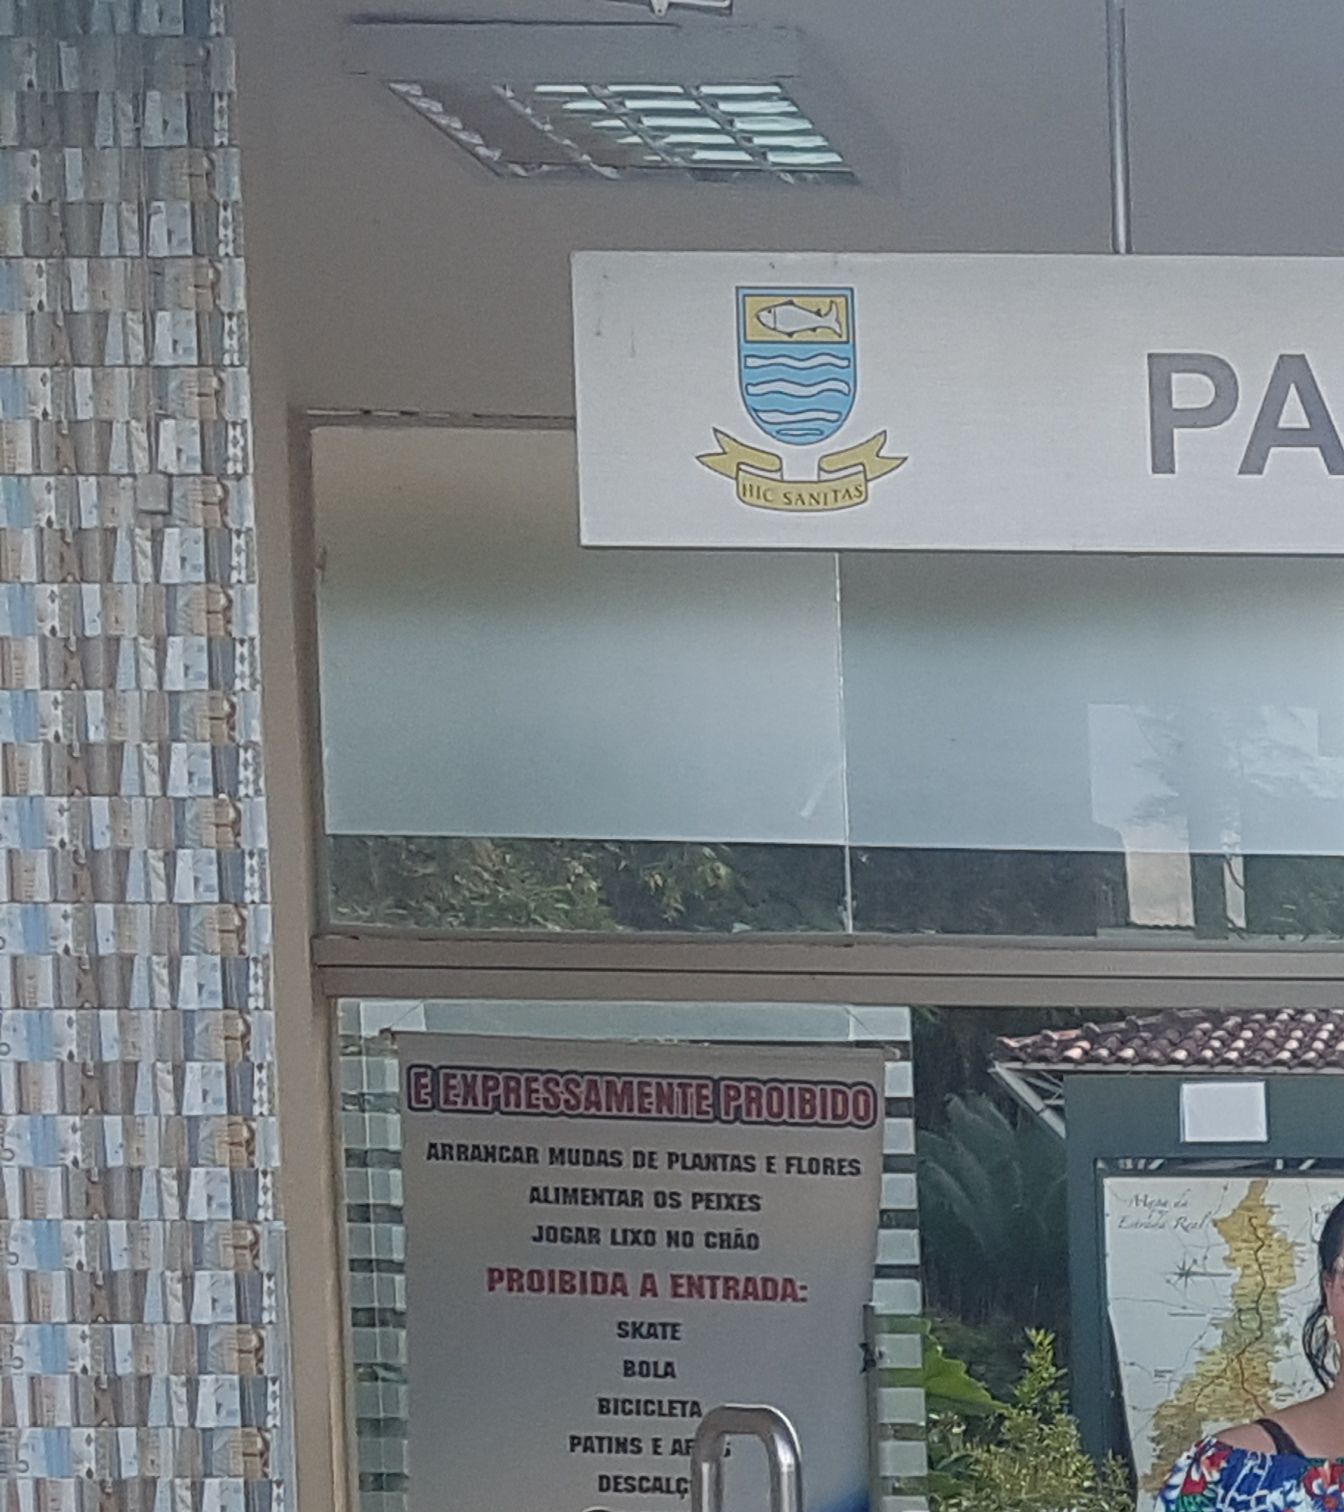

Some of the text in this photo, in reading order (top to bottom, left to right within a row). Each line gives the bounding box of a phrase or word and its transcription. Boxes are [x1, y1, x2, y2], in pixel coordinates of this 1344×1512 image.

[742, 483, 864, 506] HIC SANITAS
[441, 1070, 714, 1118] EXPRESSAMENTE
[721, 1080, 873, 1124] PROIBIDO
[426, 1141, 862, 1177] ARRANCAR MUDAS DE PLANTAS E FLORES
[529, 1185, 762, 1212] ALIMENTAR OS PEIXES
[531, 1225, 760, 1251] JOGAR LIXO NO CHÃO
[487, 1266, 808, 1302] PROIBIDA A ENTRADA:
[616, 1321, 682, 1341] SKATE
[623, 1360, 677, 1379] BOLA
[597, 1398, 703, 1418] BICICLETA
[569, 1435, 643, 1456] PATINS
[652, 1437, 664, 1456] E
[598, 1474, 692, 1499] DESCALÇ
